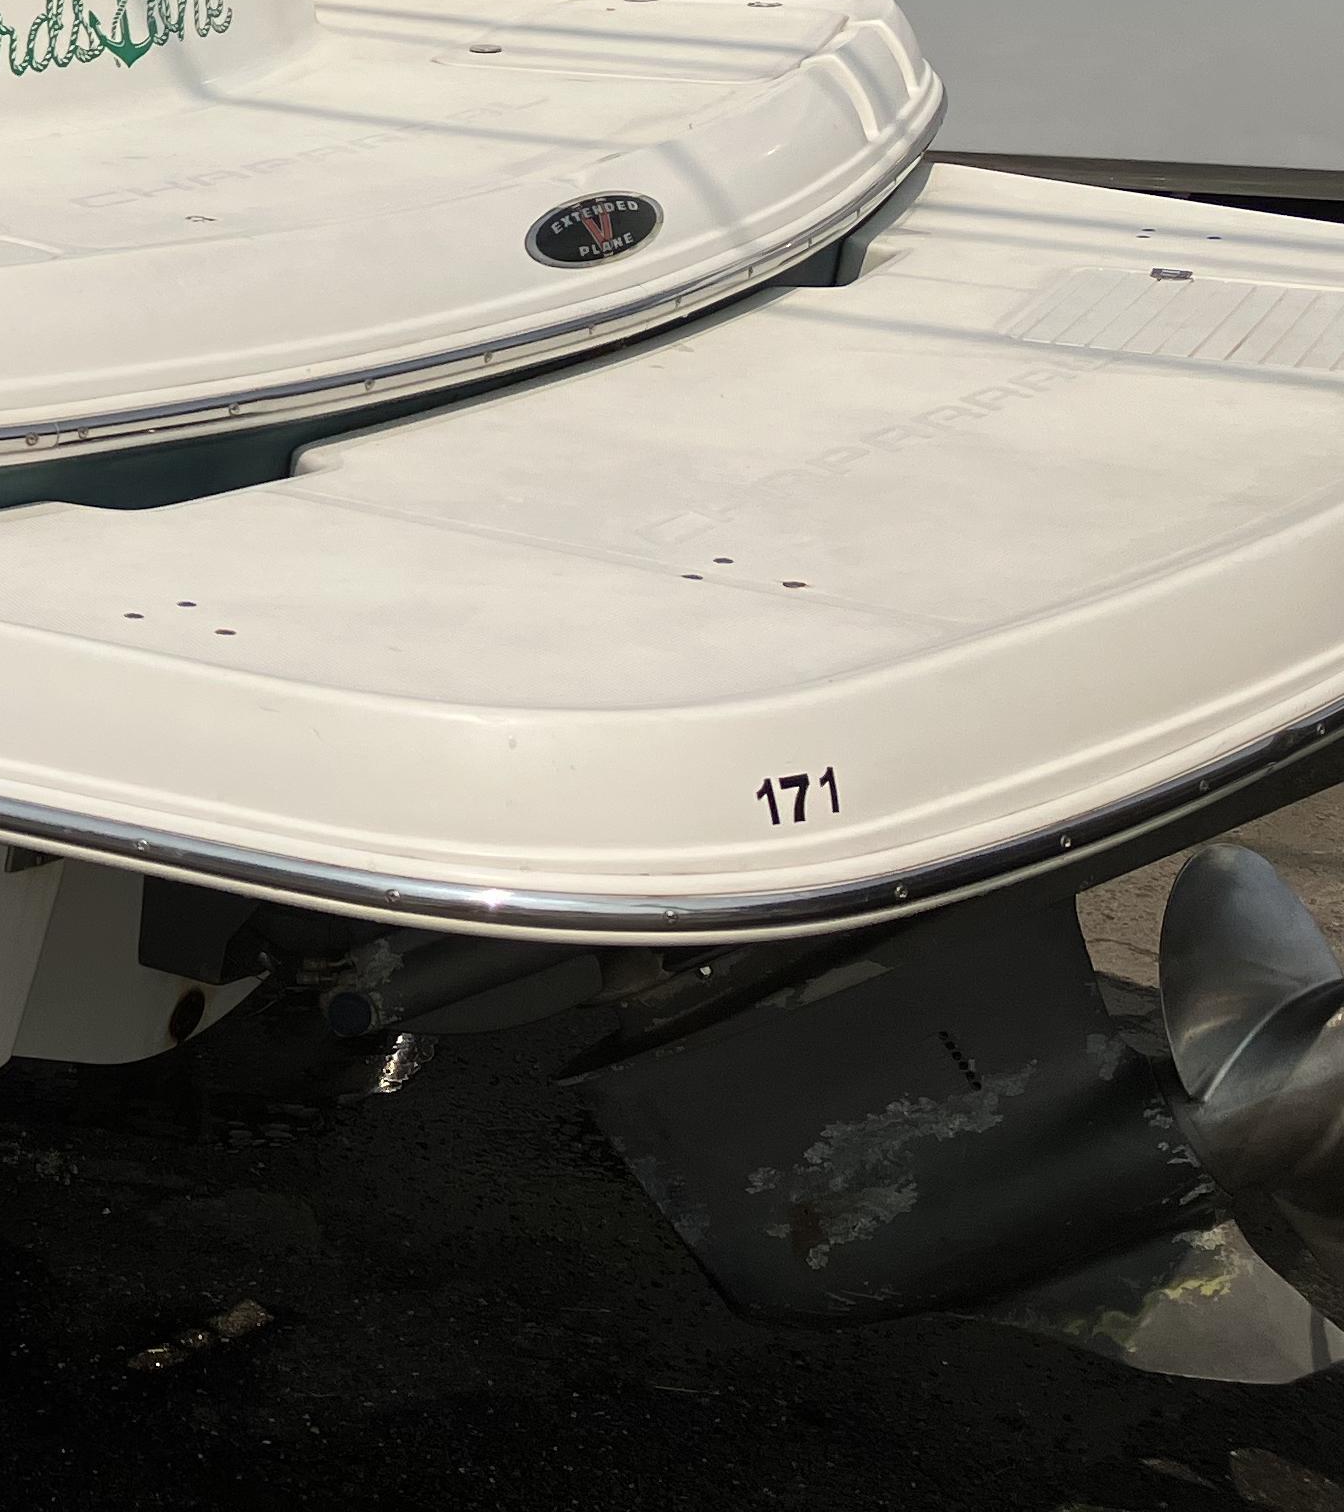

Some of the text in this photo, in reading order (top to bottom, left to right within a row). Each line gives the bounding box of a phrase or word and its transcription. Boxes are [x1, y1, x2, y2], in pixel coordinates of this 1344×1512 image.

[550, 199, 640, 235] EXTENDED
[578, 232, 634, 257] PLANE
[756, 766, 840, 826] 171
